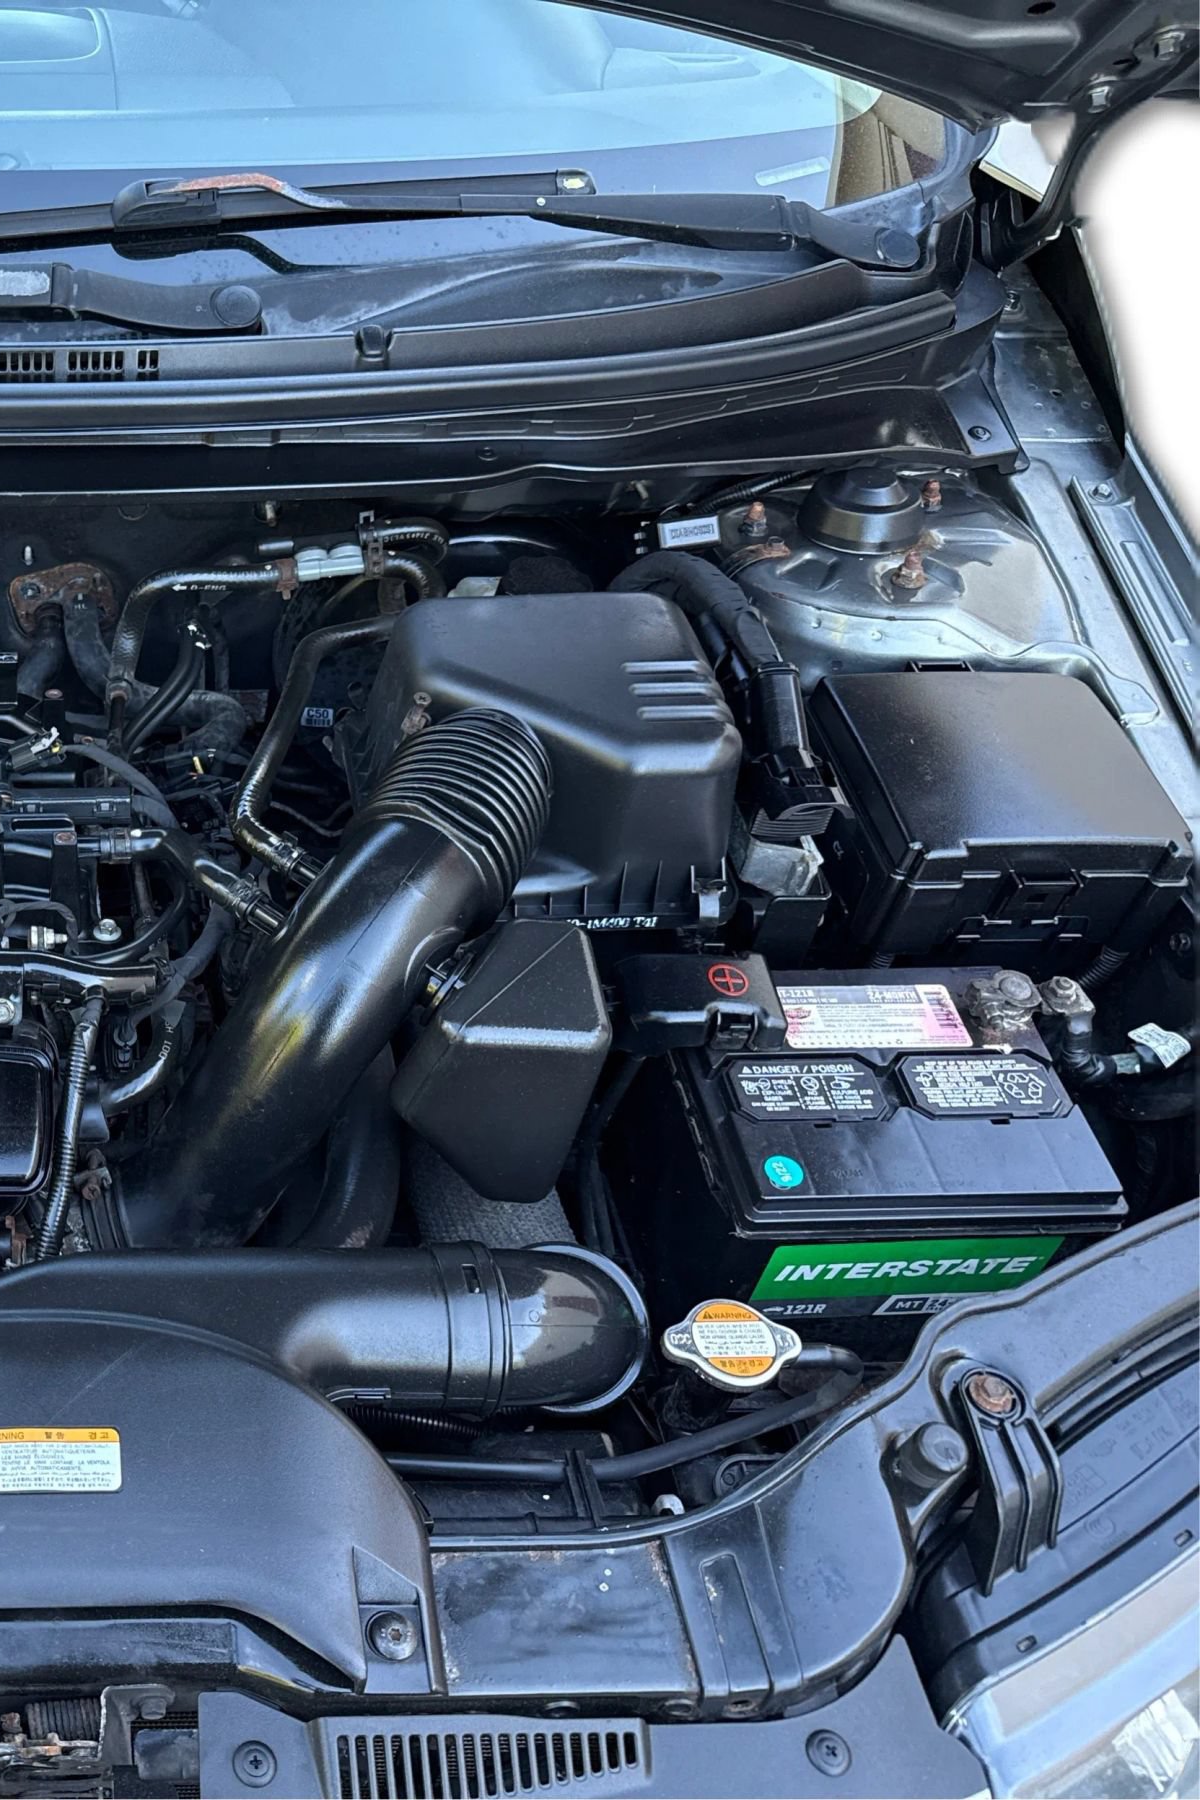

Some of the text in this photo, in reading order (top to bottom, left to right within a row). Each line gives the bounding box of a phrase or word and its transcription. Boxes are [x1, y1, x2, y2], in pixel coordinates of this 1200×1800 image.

[307, 708, 329, 719] C50
[752, 1064, 800, 1074] DANGER
[811, 1063, 854, 1073] POISON
[773, 1256, 1038, 1282] INTERSTATE
[783, 1303, 827, 1315] 121R
[895, 1300, 923, 1309] MT
[713, 1311, 752, 1320] WARNING
